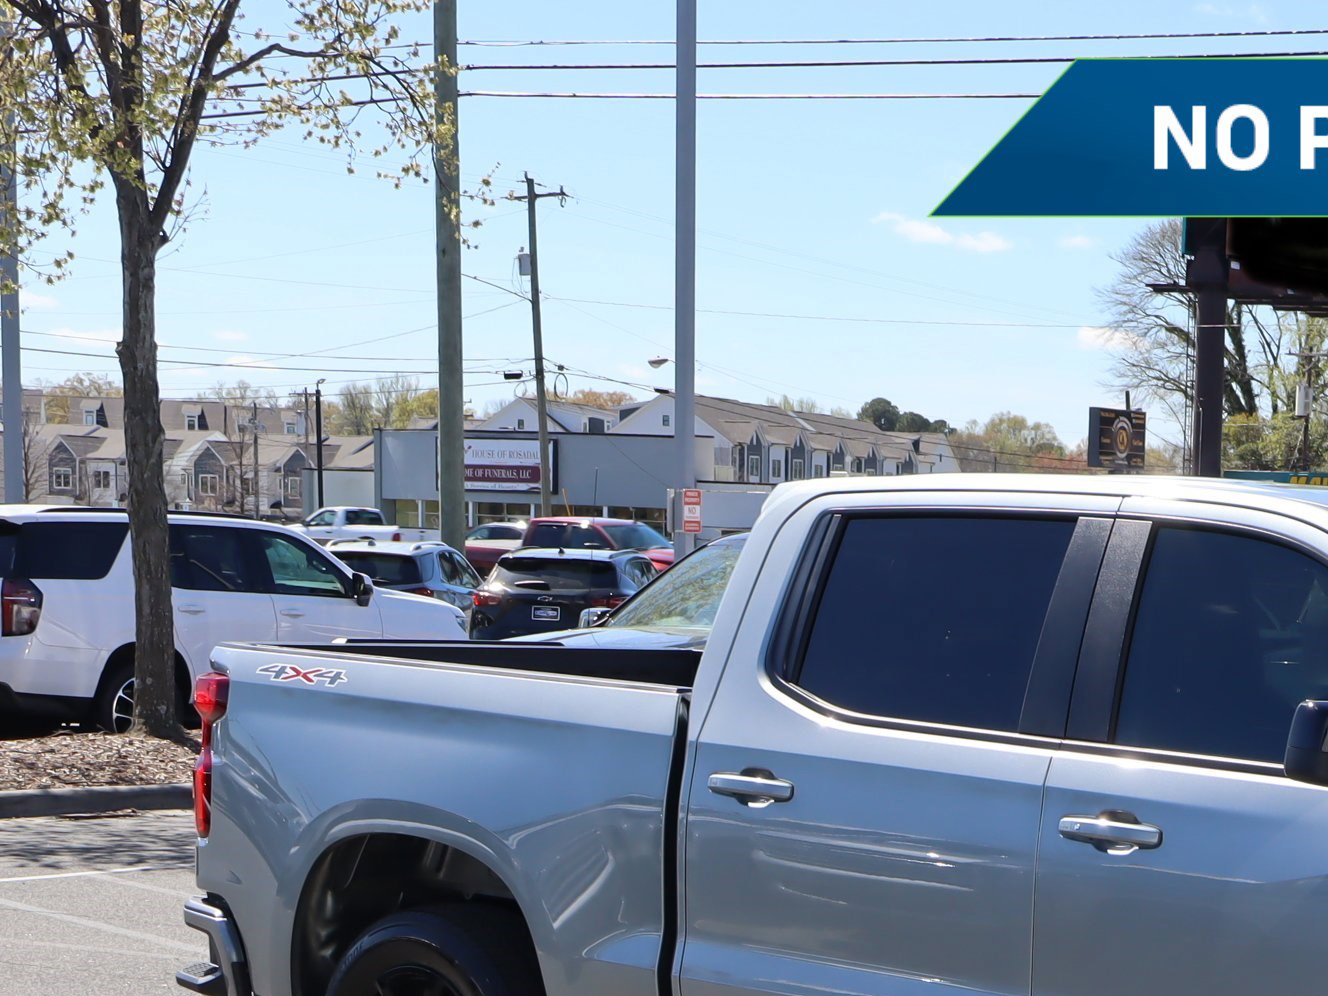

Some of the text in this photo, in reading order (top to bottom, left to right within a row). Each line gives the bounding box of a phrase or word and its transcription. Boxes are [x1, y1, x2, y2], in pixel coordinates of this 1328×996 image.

[472, 449, 540, 460] HOUSE OF ROSADAL
[464, 468, 532, 480] ME OF FUNERALS, LLC
